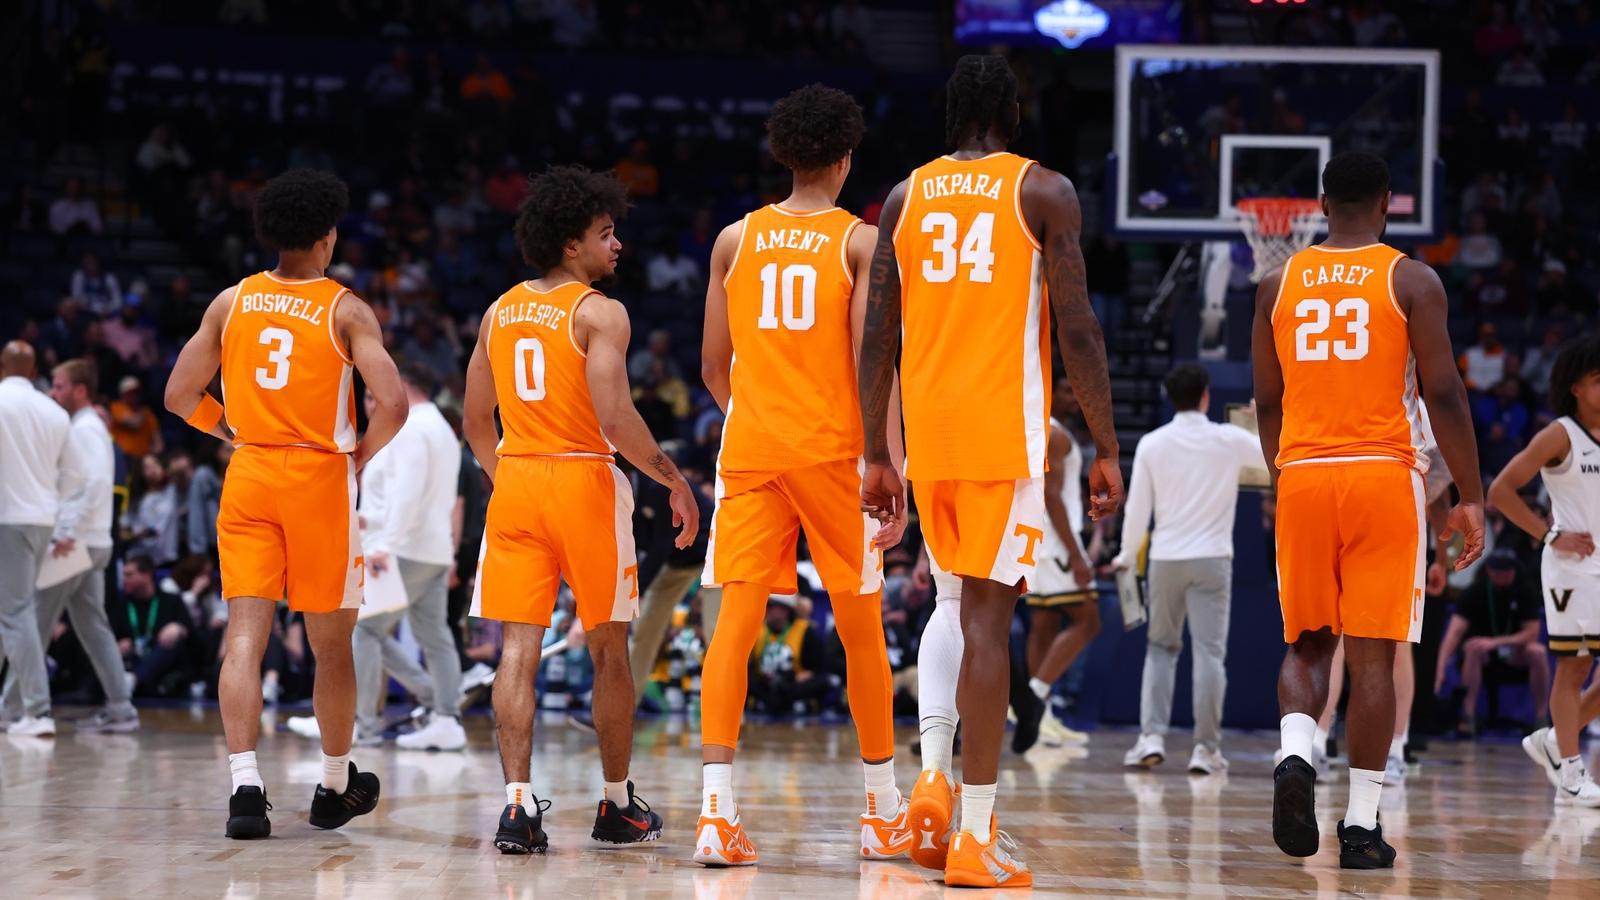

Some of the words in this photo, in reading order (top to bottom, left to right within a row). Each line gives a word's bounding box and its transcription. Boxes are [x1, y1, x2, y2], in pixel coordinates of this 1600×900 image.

[922, 173, 1002, 200] OKPARA
[755, 229, 830, 253] AMENT
[921, 211, 995, 283] 34
[1302, 264, 1374, 288] CAREY
[242, 293, 324, 325] BOSWELL
[757, 263, 817, 330] 10
[498, 302, 566, 330] GILLESPIE
[1295, 297, 1370, 361] 23
[255, 327, 294, 390] 3
[514, 337, 546, 401] 0
[1013, 523, 1043, 567] T
[1550, 589, 1574, 612] V
